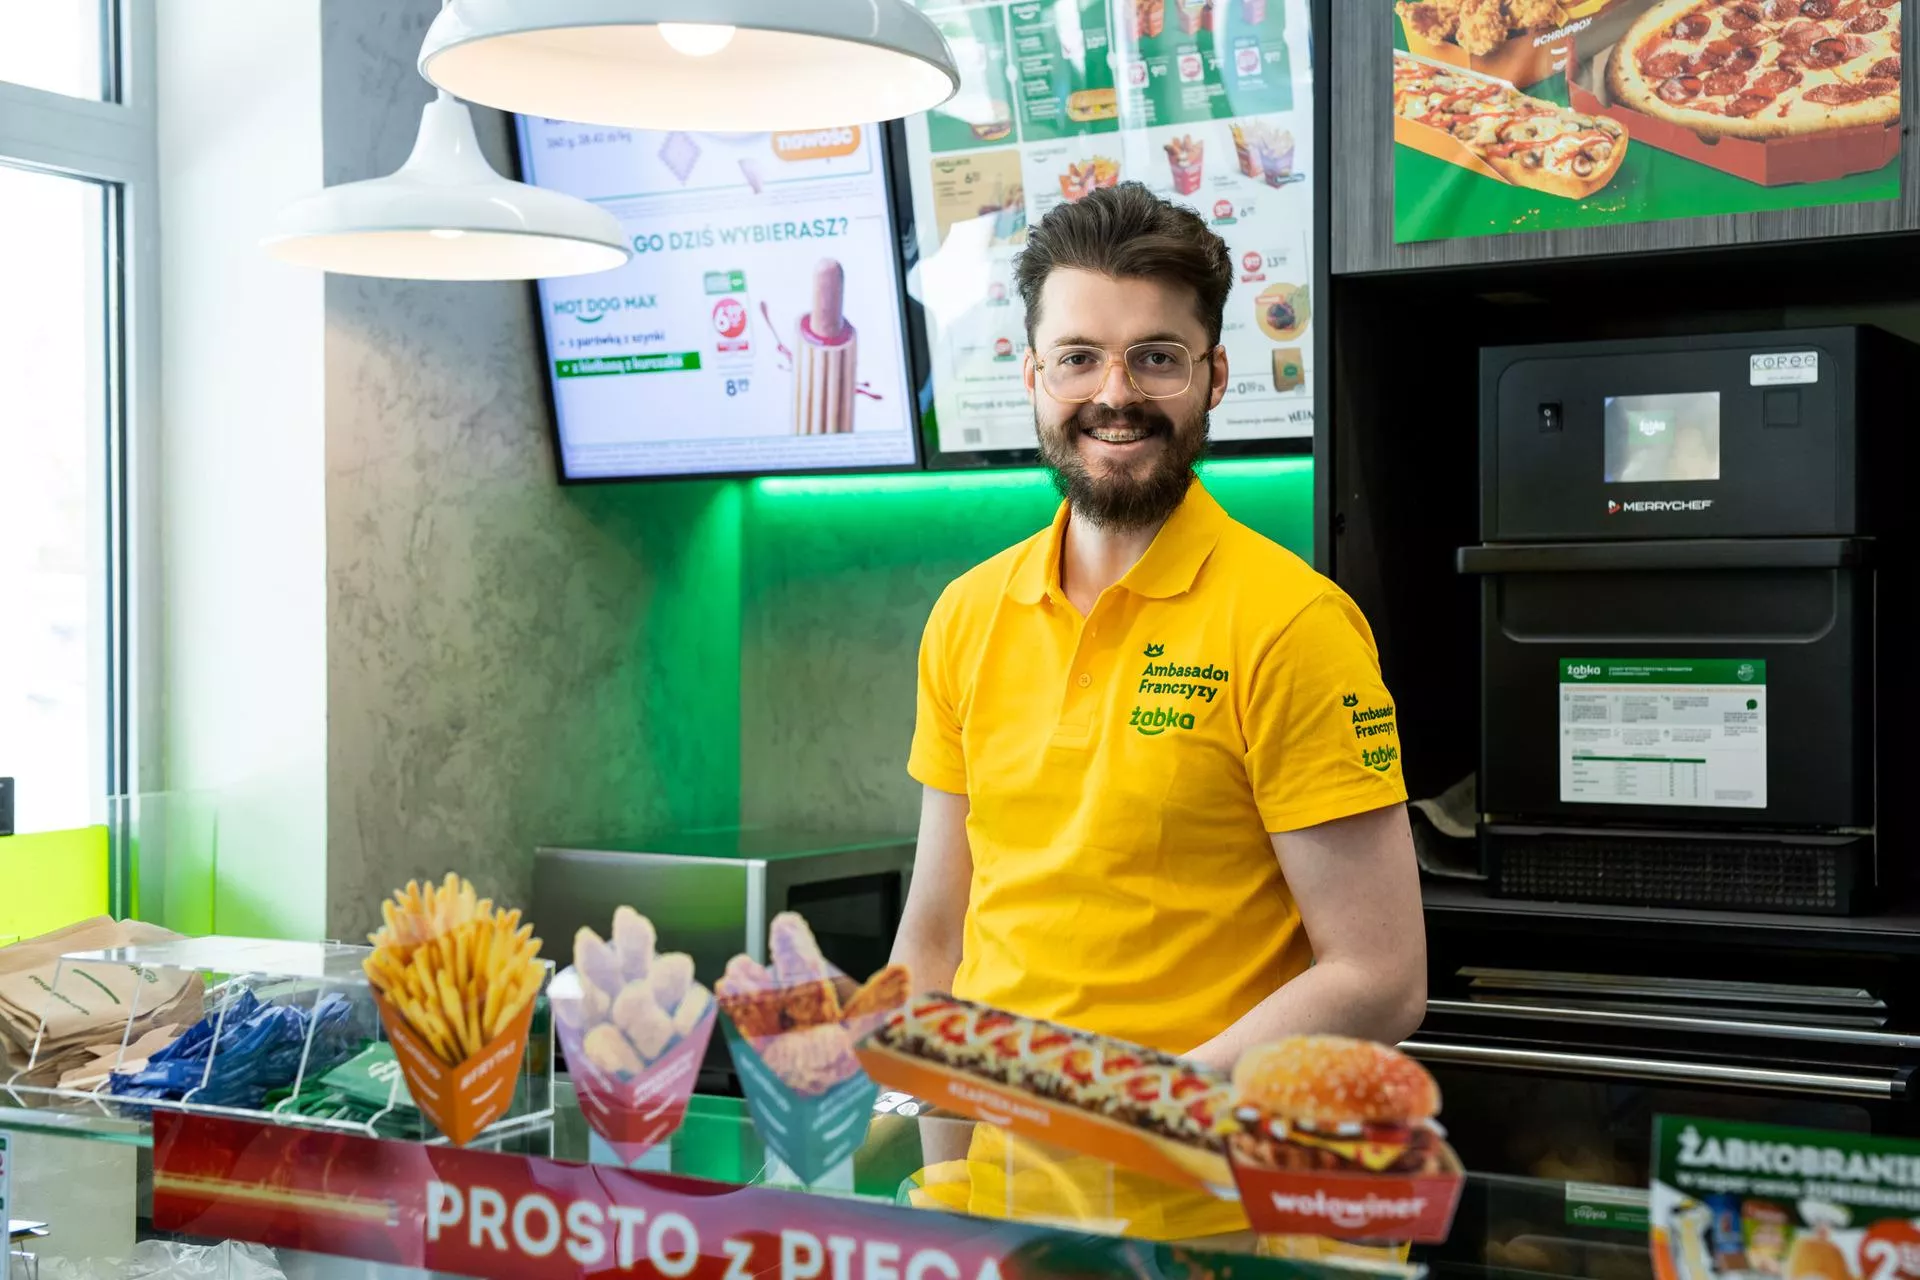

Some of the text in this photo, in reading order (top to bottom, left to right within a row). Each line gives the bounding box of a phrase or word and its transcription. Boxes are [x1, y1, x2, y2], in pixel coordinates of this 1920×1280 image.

[1533, 17, 1592, 48] #CHRUPBOX
[669, 224, 714, 250] DZIŚ
[719, 217, 850, 245] WYBIERASZ?
[554, 295, 657, 314] HOT DOG MAX
[1623, 499, 1713, 512] MERRYCHEF
[1567, 664, 1601, 679] żabka
[1138, 678, 1218, 703] Franczyzy
[1129, 705, 1196, 735] żabka
[426, 1180, 701, 1277] PROSTO
